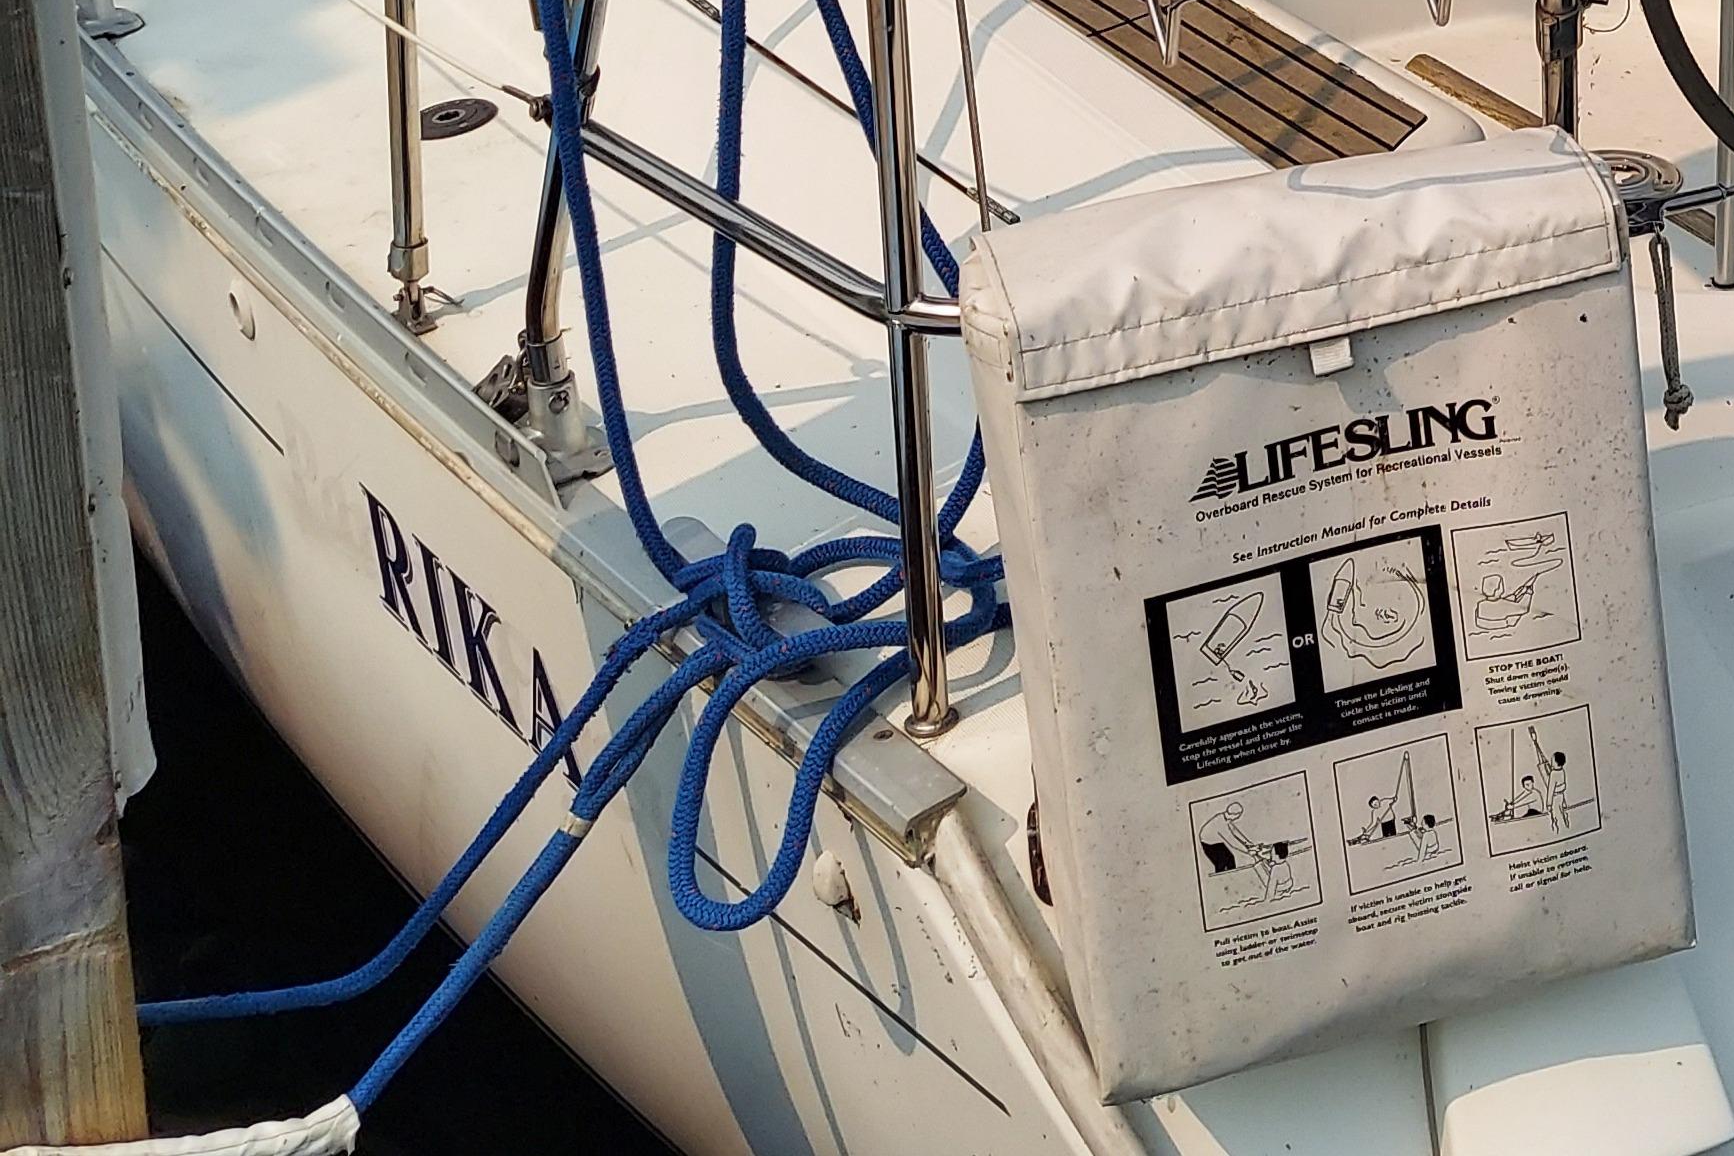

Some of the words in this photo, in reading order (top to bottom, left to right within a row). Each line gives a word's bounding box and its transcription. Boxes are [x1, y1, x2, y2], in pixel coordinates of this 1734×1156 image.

[1236, 399, 1498, 494] LIFESLING
[1195, 496, 1259, 522] Overboard
[1262, 485, 1306, 504] Rescue
[1308, 471, 1353, 494] System
[1356, 467, 1373, 480] for
[1376, 448, 1451, 475] Recreational
[1454, 445, 1502, 460] Vessels
[1232, 551, 1253, 564] See
[1257, 533, 1318, 557] Instruction
[1321, 517, 1366, 540] Manual
[1368, 513, 1387, 529] for
[1390, 501, 1447, 521] Complete
[1450, 497, 1492, 512] Details
[359, 481, 583, 793] RIKA
[1292, 631, 1315, 648] OR
[1488, 663, 1514, 673] STOP
[1514, 660, 1533, 670] THE
